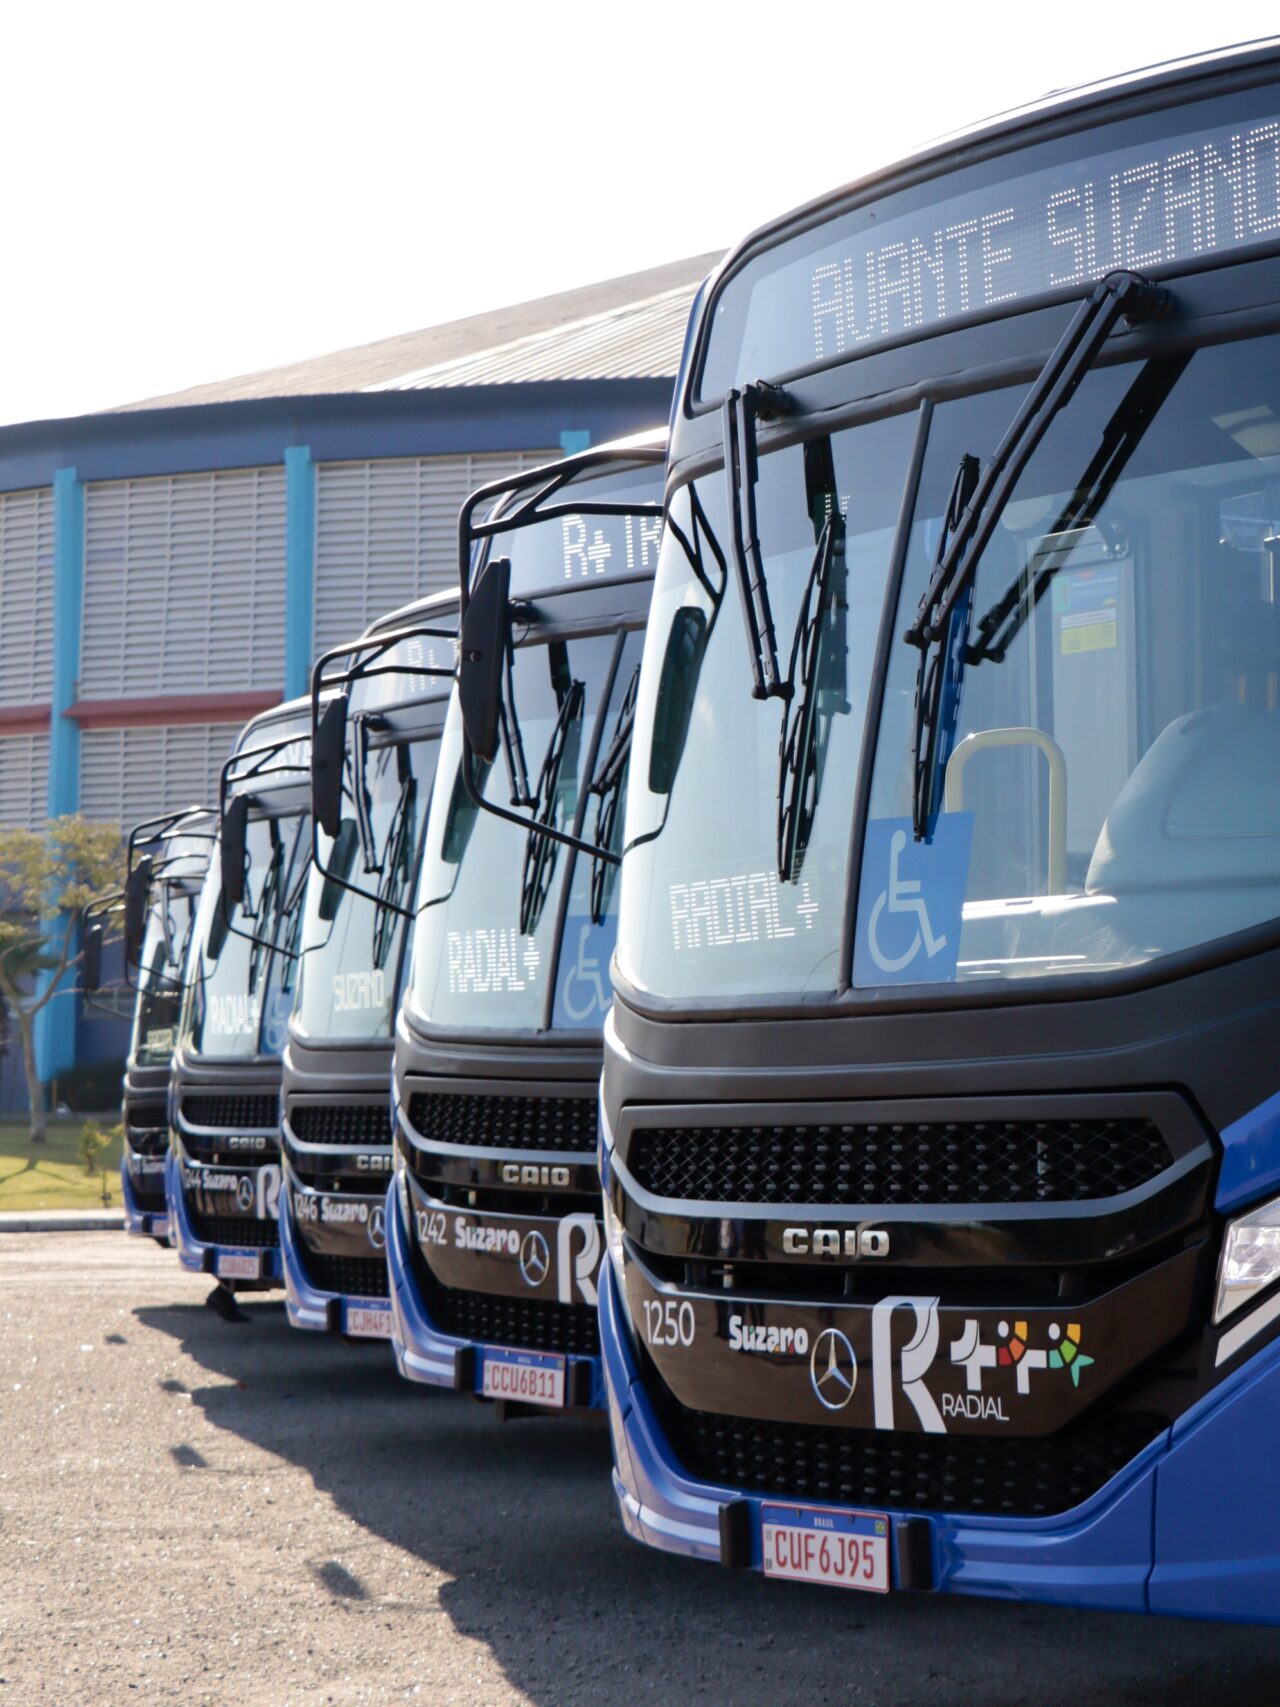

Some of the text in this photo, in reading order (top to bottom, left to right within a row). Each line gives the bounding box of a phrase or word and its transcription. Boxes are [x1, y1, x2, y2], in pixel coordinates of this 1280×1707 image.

[333, 970, 384, 1011] SUZANO
[229, 1136, 266, 1150] CAIO
[356, 1155, 394, 1170] CAI
[503, 1165, 570, 1186] CAIO
[782, 1228, 890, 1257] CAIO
[643, 1300, 695, 1346] 1250
[492, 1365, 555, 1398] CCU6B11
[942, 1393, 1010, 1421] RADIAL
[814, 1517, 834, 1529] BRASIL
[775, 1531, 875, 1580] CUF6J95
